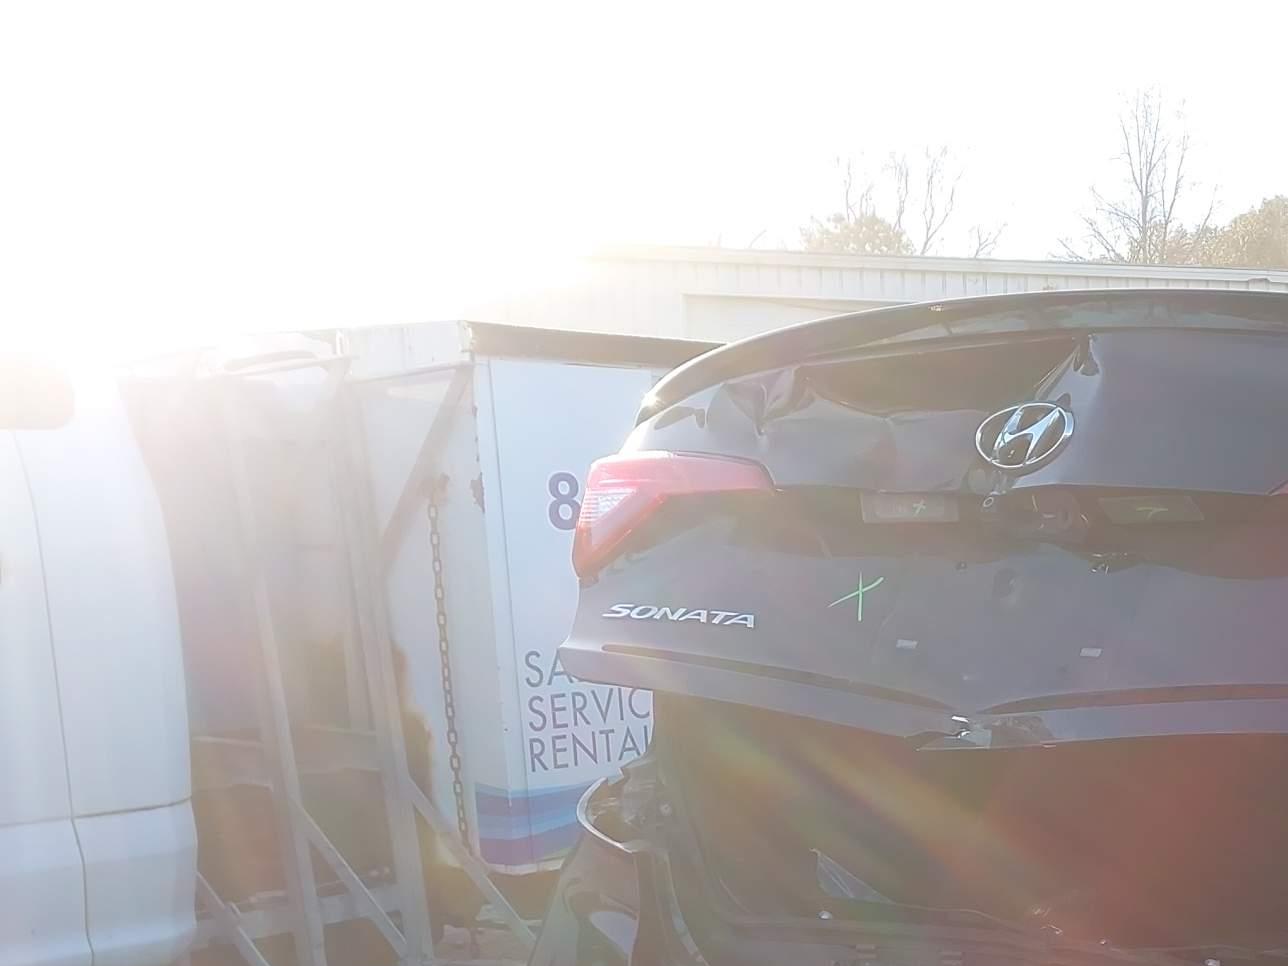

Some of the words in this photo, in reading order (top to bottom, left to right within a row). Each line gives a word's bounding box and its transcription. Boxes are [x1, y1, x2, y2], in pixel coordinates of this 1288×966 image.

[602, 602, 755, 629] SONATA
[524, 649, 575, 688] SA
[527, 687, 651, 732] SERVIC
